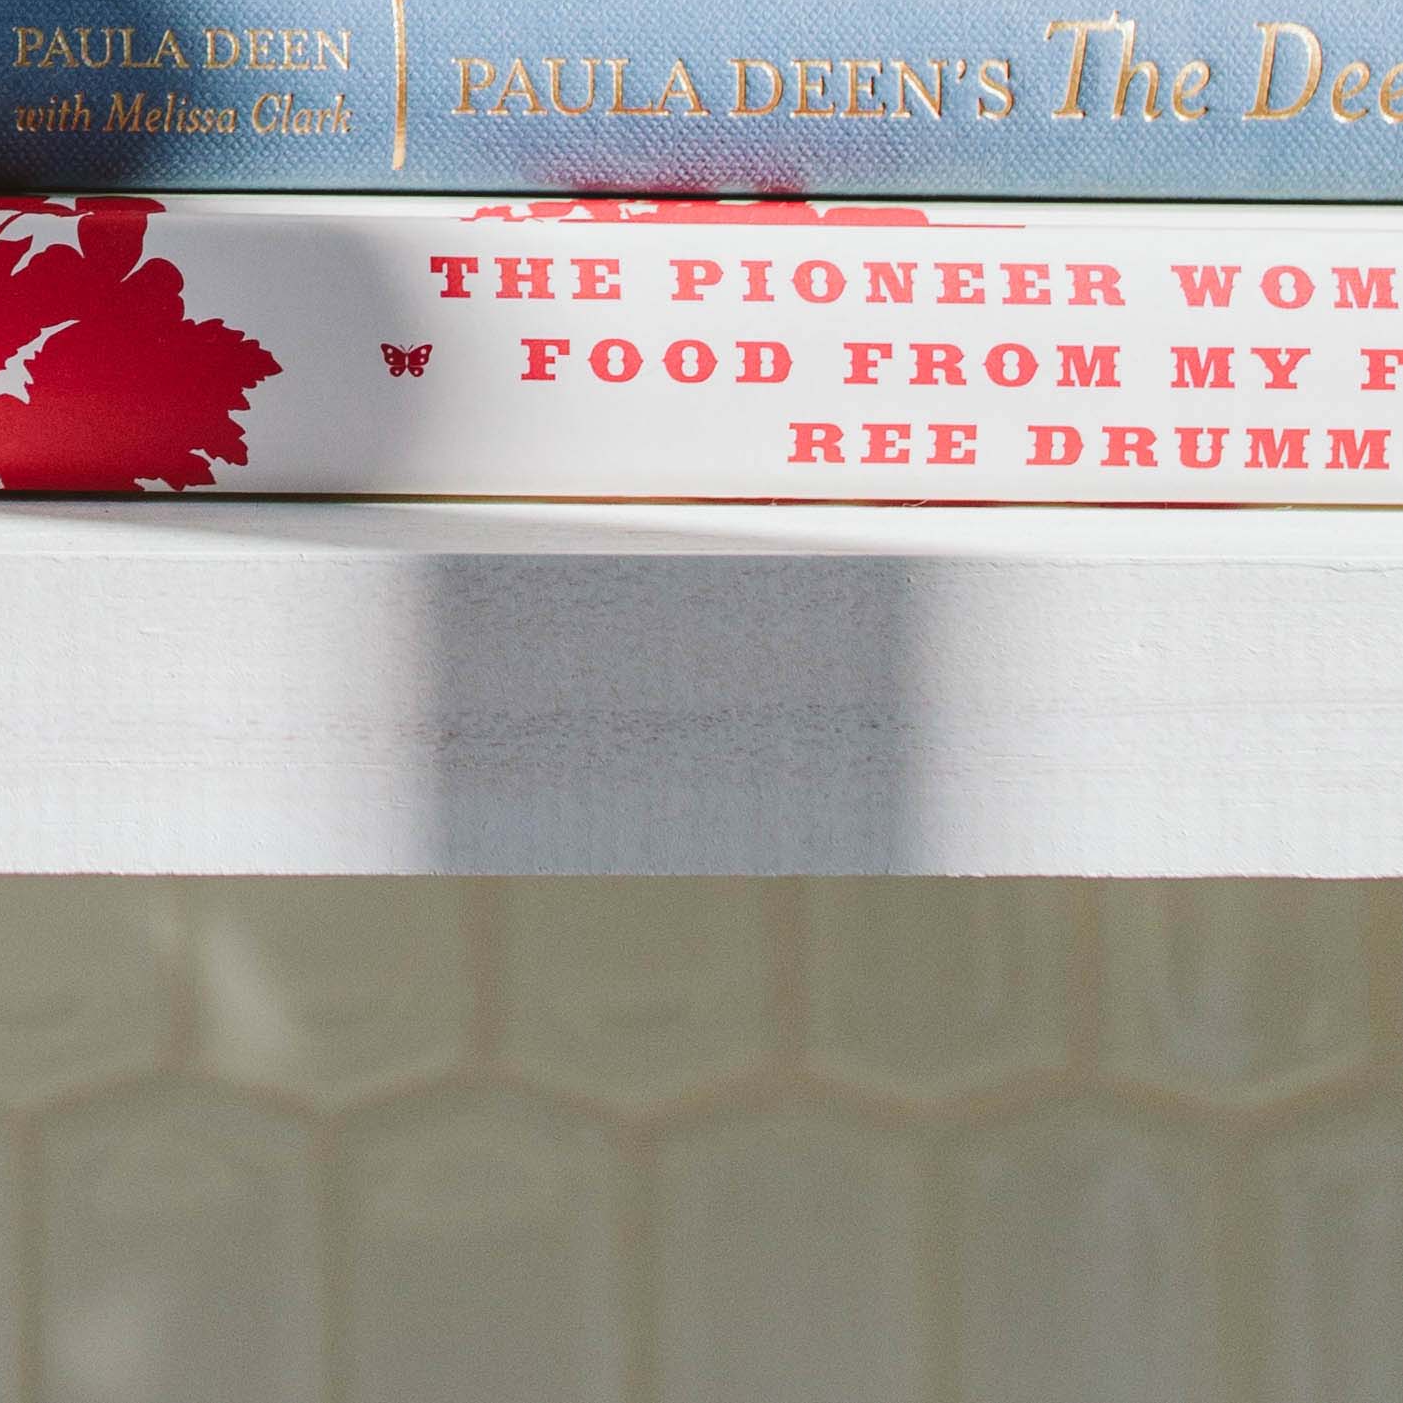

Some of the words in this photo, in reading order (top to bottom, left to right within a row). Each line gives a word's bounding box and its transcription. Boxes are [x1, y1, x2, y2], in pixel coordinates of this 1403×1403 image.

[13, 26, 186, 70] PAULA
[202, 26, 352, 72] DEEN
[451, 56, 710, 116] PAULA
[728, 57, 1014, 121] DEEN'S
[1046, 9, 1212, 122] The
[14, 94, 92, 132] with
[102, 98, 238, 135] Melissa
[250, 91, 354, 135] Clark
[428, 255, 623, 301] THE
[670, 258, 1127, 307] PIONEER
[1170, 264, 1399, 310] WOM
[519, 336, 794, 385] FOOD
[843, 341, 1122, 389] FROM
[1170, 345, 1311, 390] MY
[788, 421, 979, 467] REE
[1026, 423, 1392, 470] DRUMM
